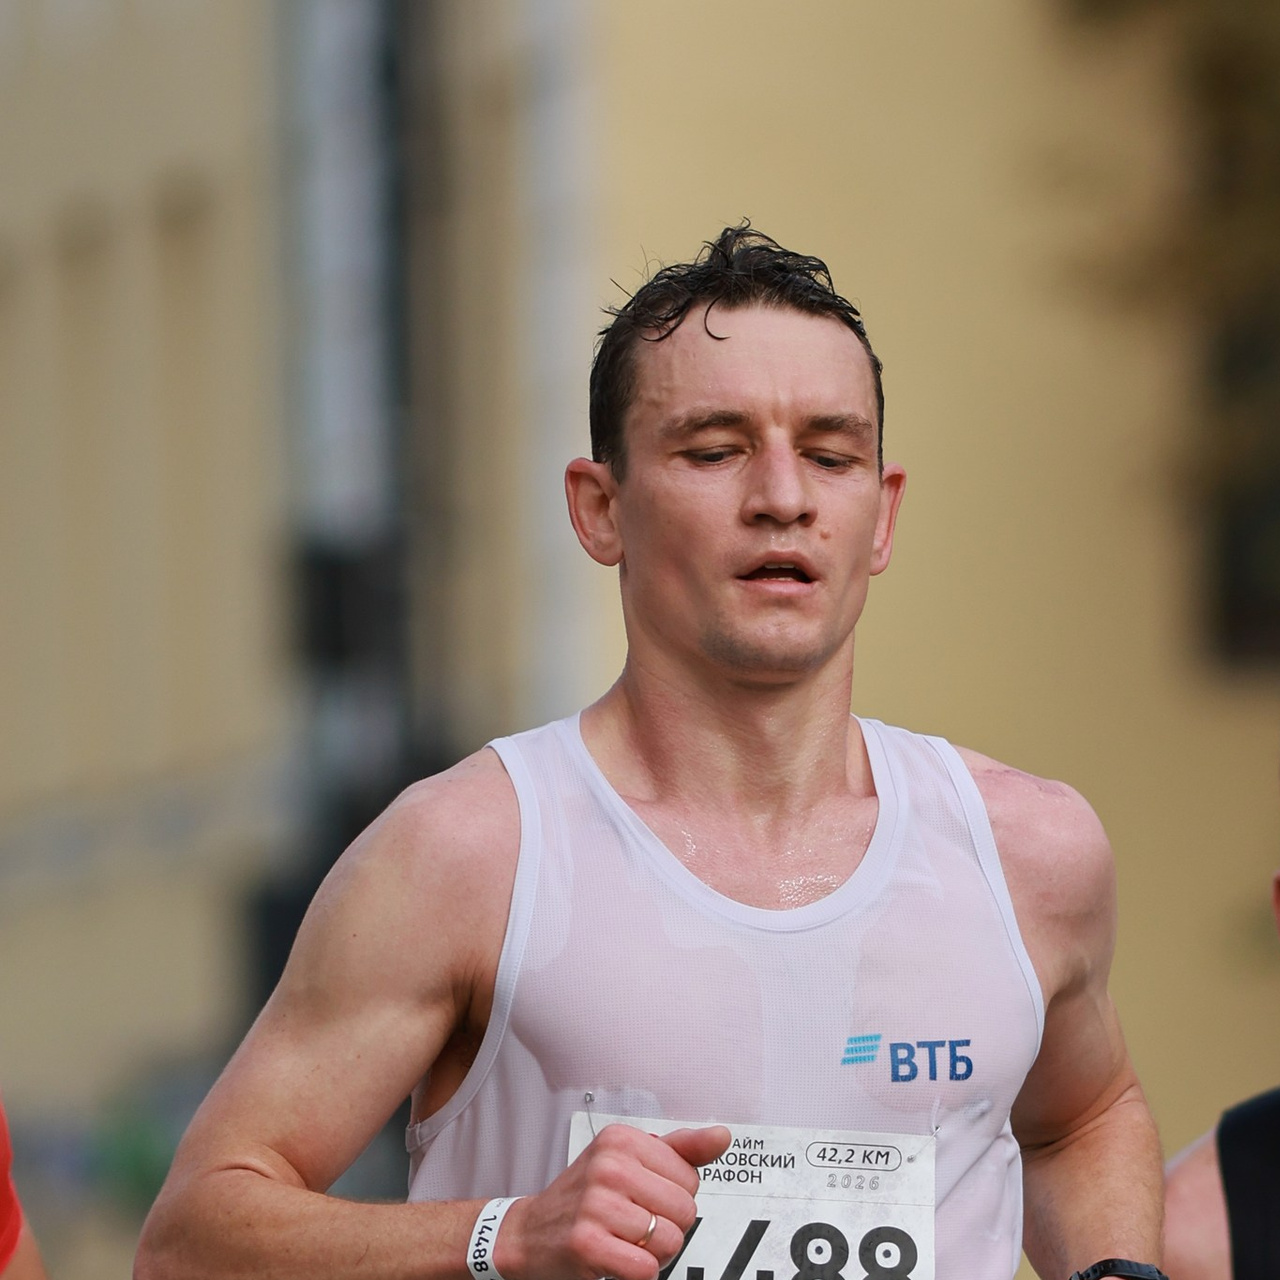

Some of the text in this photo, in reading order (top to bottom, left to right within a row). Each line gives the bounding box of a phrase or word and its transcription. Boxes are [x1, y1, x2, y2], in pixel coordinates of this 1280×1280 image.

[889, 1039, 973, 1082] ВТБ
[732, 1137, 764, 1150] АЙМ
[708, 1152, 795, 1168] КОВСКИЙ
[816, 1147, 855, 1165] 42,2
[696, 1168, 762, 1183] РАФОН
[826, 1174, 880, 1190] 2026
[473, 1215, 497, 1272] 14488
